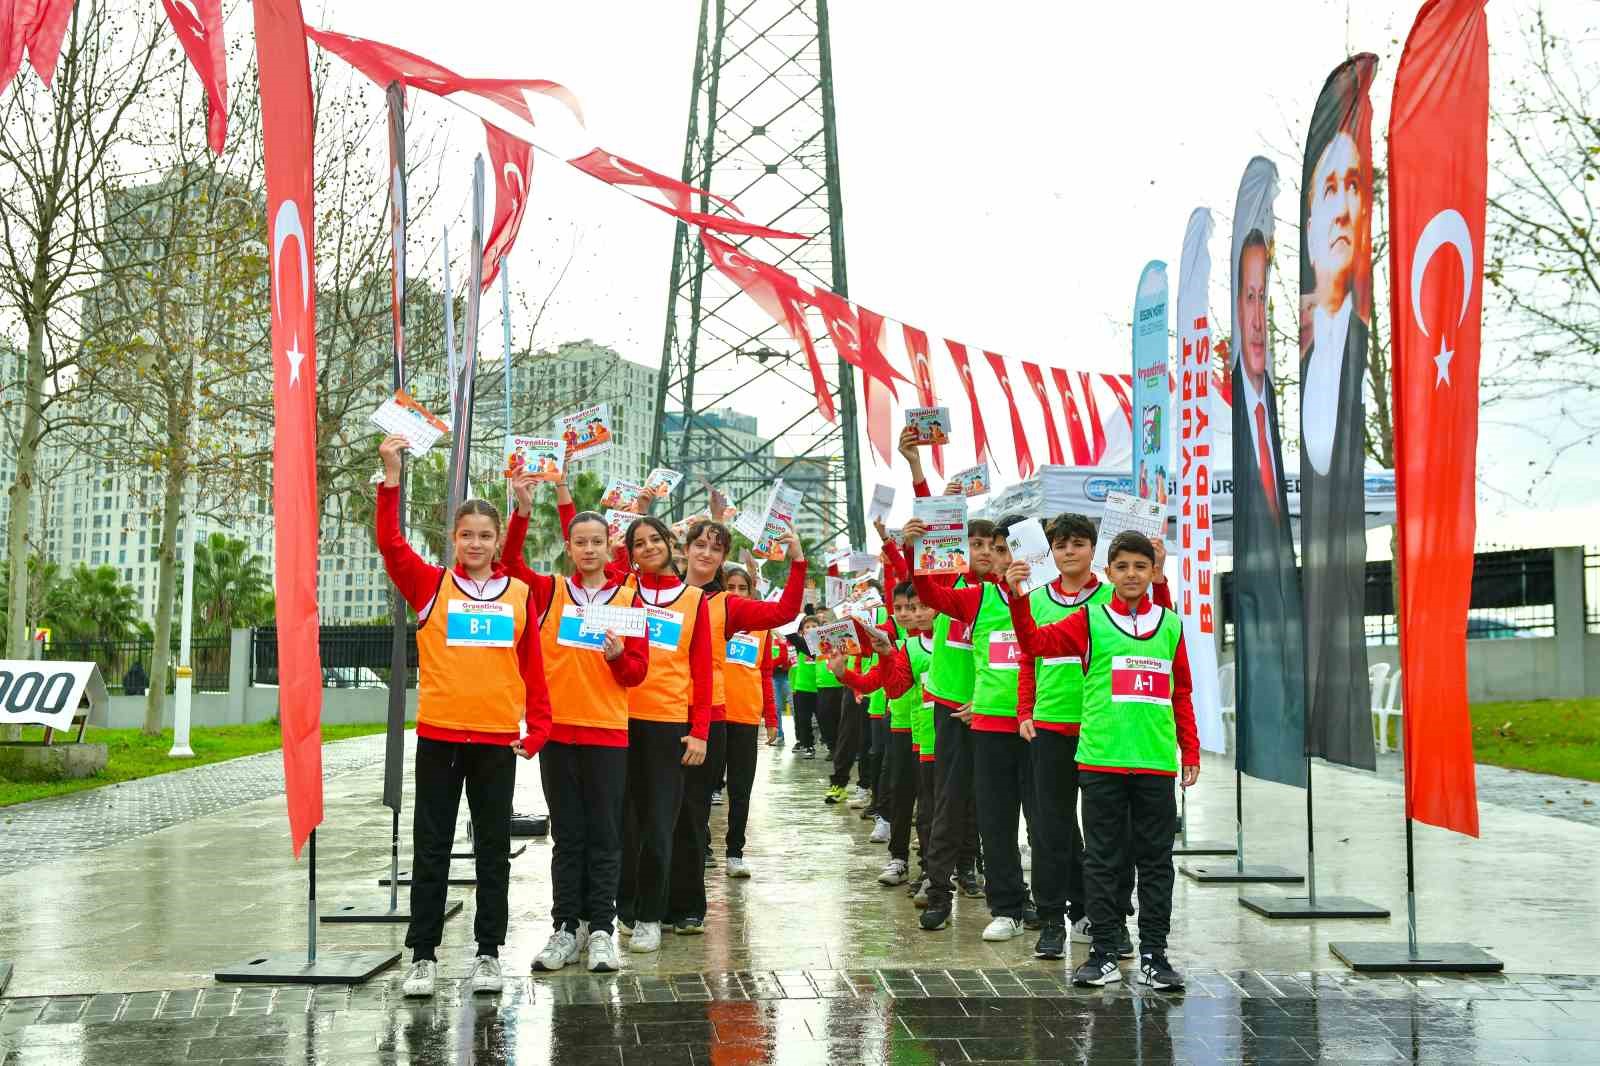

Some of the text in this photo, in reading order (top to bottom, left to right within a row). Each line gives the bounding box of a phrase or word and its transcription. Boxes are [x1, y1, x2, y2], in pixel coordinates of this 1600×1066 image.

[1182, 336, 1192, 616] ESENYURT
[1193, 317, 1214, 634] BELEDİYESİ
[470, 618, 492, 635] B-1
[730, 643, 747, 656] B-7
[1133, 674, 1153, 692] A-1
